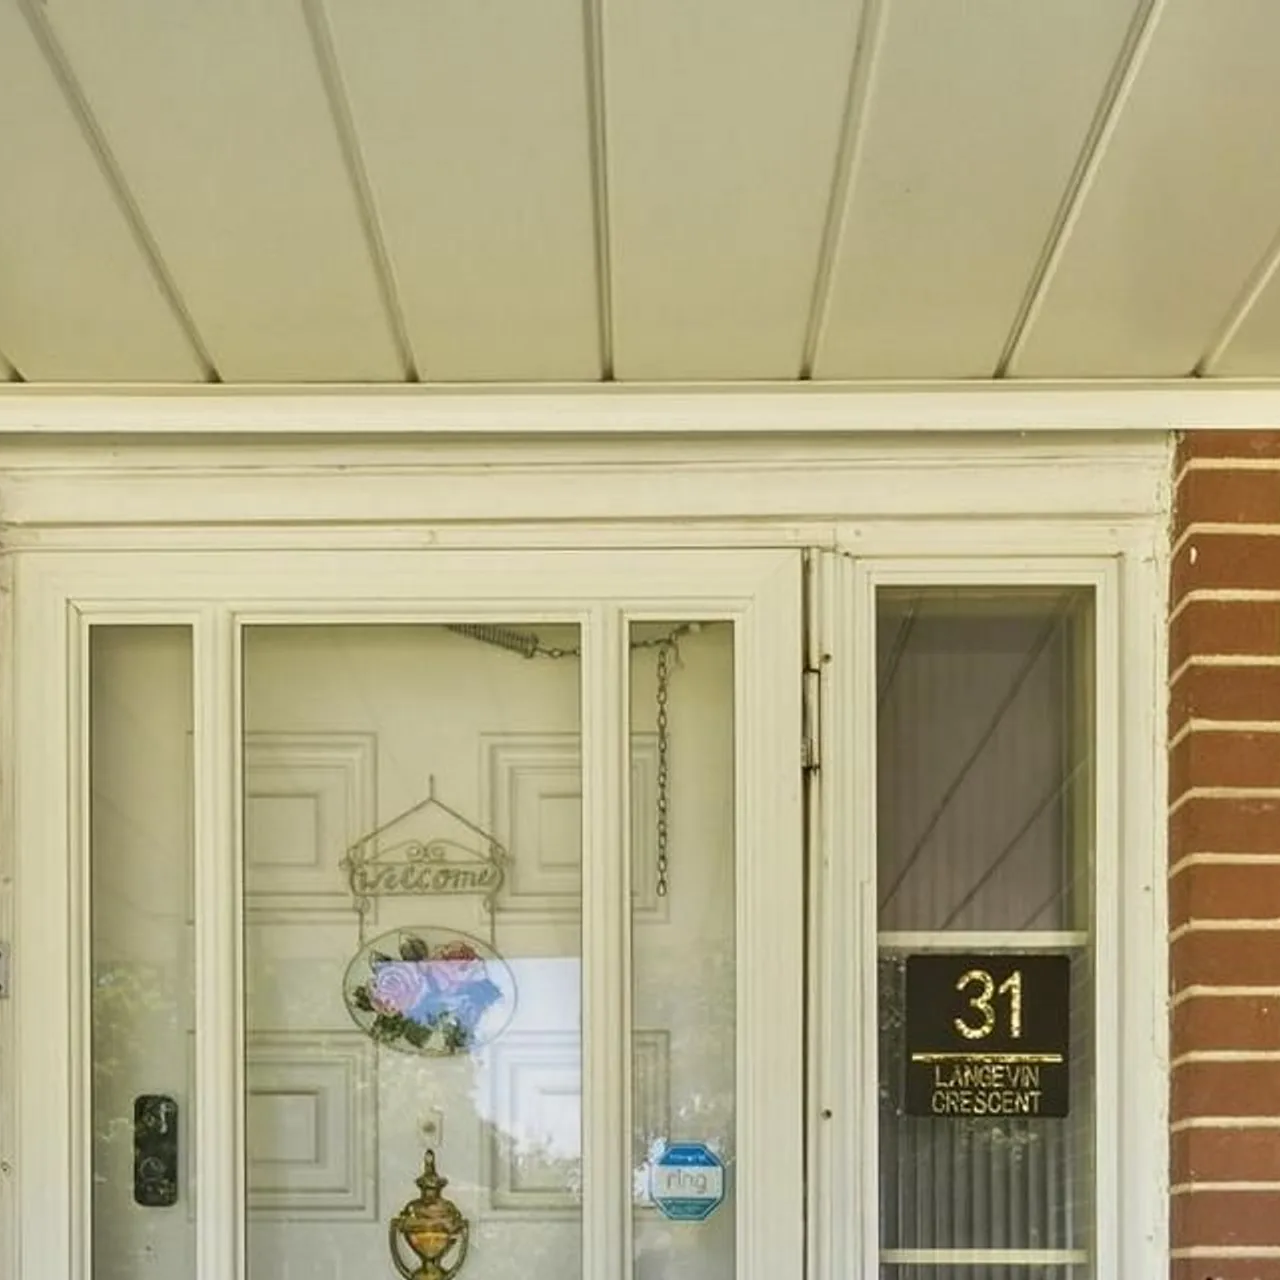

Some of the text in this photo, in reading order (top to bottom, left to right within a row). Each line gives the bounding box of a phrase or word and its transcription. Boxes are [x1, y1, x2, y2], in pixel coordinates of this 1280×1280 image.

[954, 970, 1021, 1039] 31
[932, 1090, 1042, 1114] CRESCENT
[667, 1168, 707, 1195] ring
